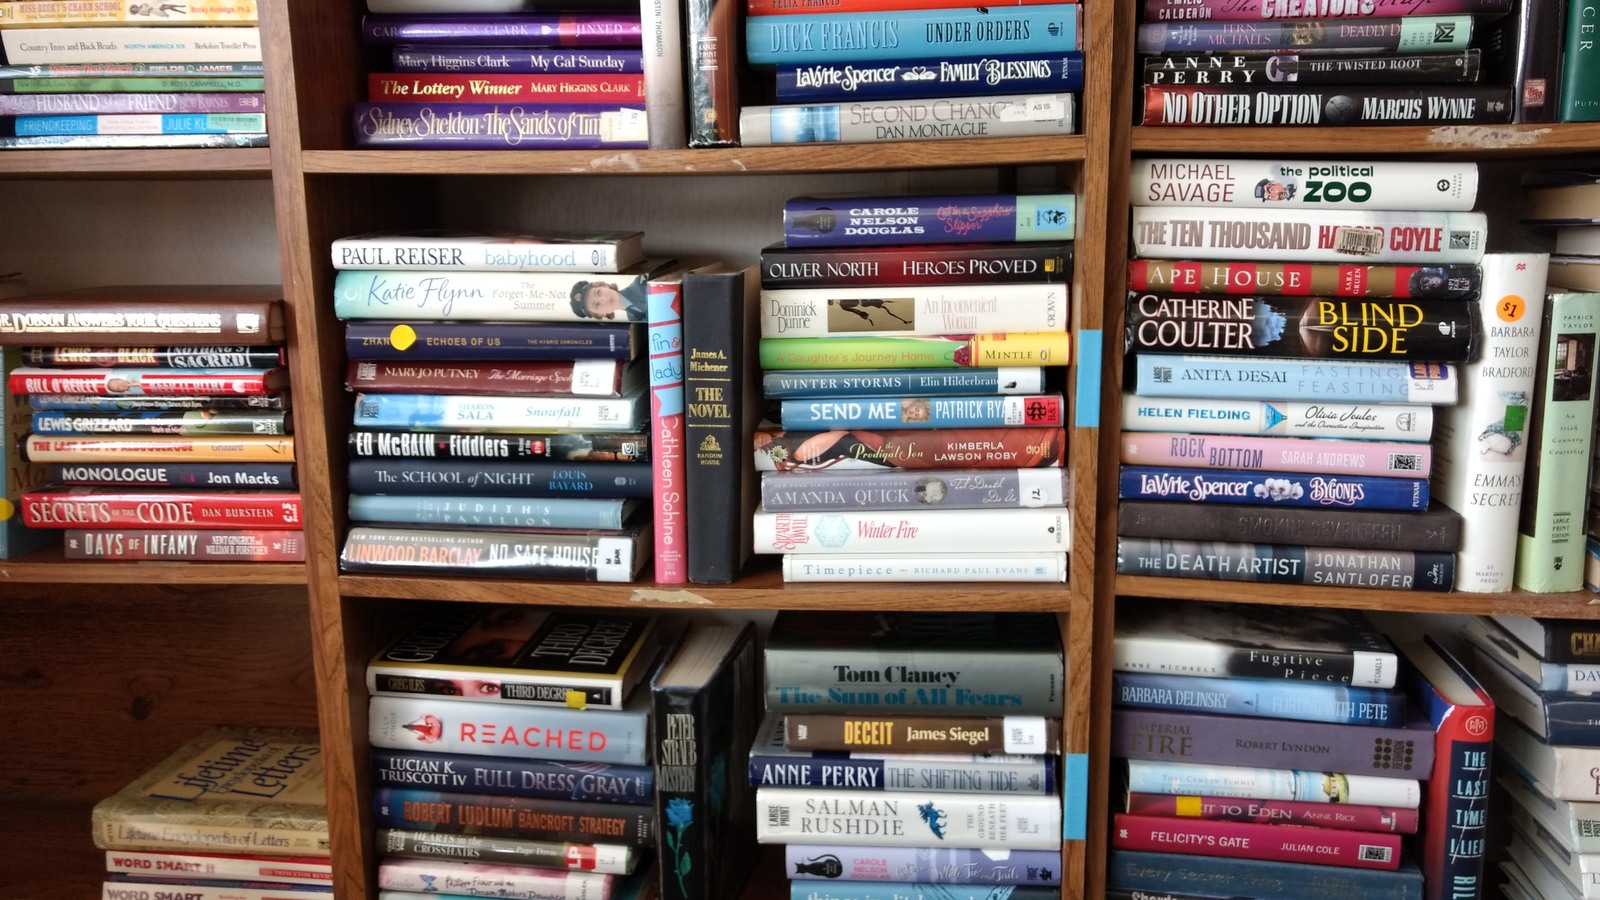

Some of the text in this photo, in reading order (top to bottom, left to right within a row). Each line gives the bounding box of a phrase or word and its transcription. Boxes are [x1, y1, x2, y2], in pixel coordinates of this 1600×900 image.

[68, 2, 93, 12] CHARM
[96, 1, 122, 11] SCHOOL
[1159, 6, 1211, 19] CALDERÓN
[576, 23, 623, 36] JINXED
[771, 20, 899, 53] DICK FRANCIS
[926, 20, 1031, 44] UNDER ORDERS
[1341, 24, 1388, 37] DEADLY
[20, 42, 117, 53] Country Inns and Back Roads
[1208, 34, 1271, 45] MICHAELS
[399, 55, 510, 70] Mary Higgins Clark
[530, 55, 625, 71] My Gal Sunday
[1163, 56, 1246, 69] ANNE
[1310, 59, 1422, 71] THE TWISTED ROOT
[381, 80, 522, 98] The Lottery Winner
[1361, 96, 1476, 120] MARCUS WYNNE
[24, 119, 92, 131] FRIENDKEEPING
[363, 107, 480, 137] Sidney Sheldon
[876, 123, 988, 139] DAN MONTAGUE
[1150, 164, 1235, 181] MICHAEL
[1280, 165, 1374, 179] the political
[1302, 181, 1373, 202] ZOO
[850, 207, 919, 217] CAROLE
[850, 217, 918, 226] NELSON
[845, 226, 925, 236] DOUGLAS
[342, 247, 465, 266] PAUL REISER
[485, 249, 576, 268] babyhood
[769, 261, 879, 278] OLIVER NORTH
[903, 258, 1037, 276] HEROES PROVED
[1318, 301, 1424, 327] BLIND
[12, 313, 221, 332] DOBSON ANSWERS YOUR QUESTIONS
[1138, 320, 1255, 349] COULTER
[1332, 327, 1408, 354] SIDE
[1491, 327, 1535, 338] BARBARA
[426, 337, 500, 346] ECHOES OF US
[985, 350, 1033, 360] MINTLE
[1493, 347, 1529, 358] TAYLOR
[690, 361, 728, 372] Michener
[1482, 367, 1534, 378] BRADFORD
[26, 378, 51, 393] BILL
[781, 377, 901, 389] WINTER STORMS
[457, 410, 494, 421] SALA
[526, 406, 581, 417] Snowfall
[810, 402, 897, 420] SEND ME
[1138, 407, 1251, 421] HELEN FIELDING
[38, 417, 133, 432] LEWIS GRIZZARD
[947, 442, 1004, 451] KIMBERLA
[934, 450, 1018, 461] LAWSON ROBY
[1209, 447, 1263, 469] BOTTOM
[62, 467, 168, 482] MONOLOGUE
[208, 471, 279, 485] Jon Macks
[552, 470, 586, 480] LOUIS
[550, 480, 593, 491] BAYARD
[771, 488, 909, 504] AMANDA QUICK
[1032, 488, 1041, 500] 12
[29, 502, 112, 523] SECRETS
[137, 502, 195, 523] CODE
[201, 508, 274, 518] DAN BURSTEIN
[443, 503, 550, 514] JUDITH'S
[444, 515, 550, 526] PAVILION
[858, 520, 919, 539] Winter Fire
[85, 534, 198, 555] DAYS OF INFAMY
[350, 544, 482, 564] LINWOOD BARCLAY
[803, 563, 892, 577] Timepiece
[914, 566, 1029, 575] RICHARD PAUL EVANS
[1165, 553, 1301, 576] DEATH ARTIST
[1314, 554, 1401, 571] JONATHAN
[1313, 571, 1412, 588] SANTLOFER
[1122, 687, 1229, 709] BARBARA DELINSKY
[844, 721, 893, 745] DECEIT
[1130, 735, 1193, 756] FIRE
[1236, 738, 1330, 754] ROBERT LYNDON
[390, 757, 441, 774] LUCIAN
[1464, 751, 1487, 768] THE
[149, 736, 268, 803] Lifetime
[230, 744, 322, 799] Letters
[380, 769, 467, 787] TRUSCOTT IV
[474, 768, 631, 795] FULL DRESS GRAY
[1457, 779, 1487, 796] LAST
[403, 801, 514, 828] ROBERT LUDLUM
[806, 798, 899, 816] SALMAN
[1220, 804, 1292, 820] TO EDEN
[769, 804, 779, 827] LARGE
[780, 804, 790, 827] PRINT
[253, 831, 290, 847] Letters
[1151, 831, 1250, 849] FELICITY'S GATE
[1280, 842, 1340, 855] JULIAN COLE
[569, 846, 582, 868] LP
[853, 858, 888, 867] CAROLE
